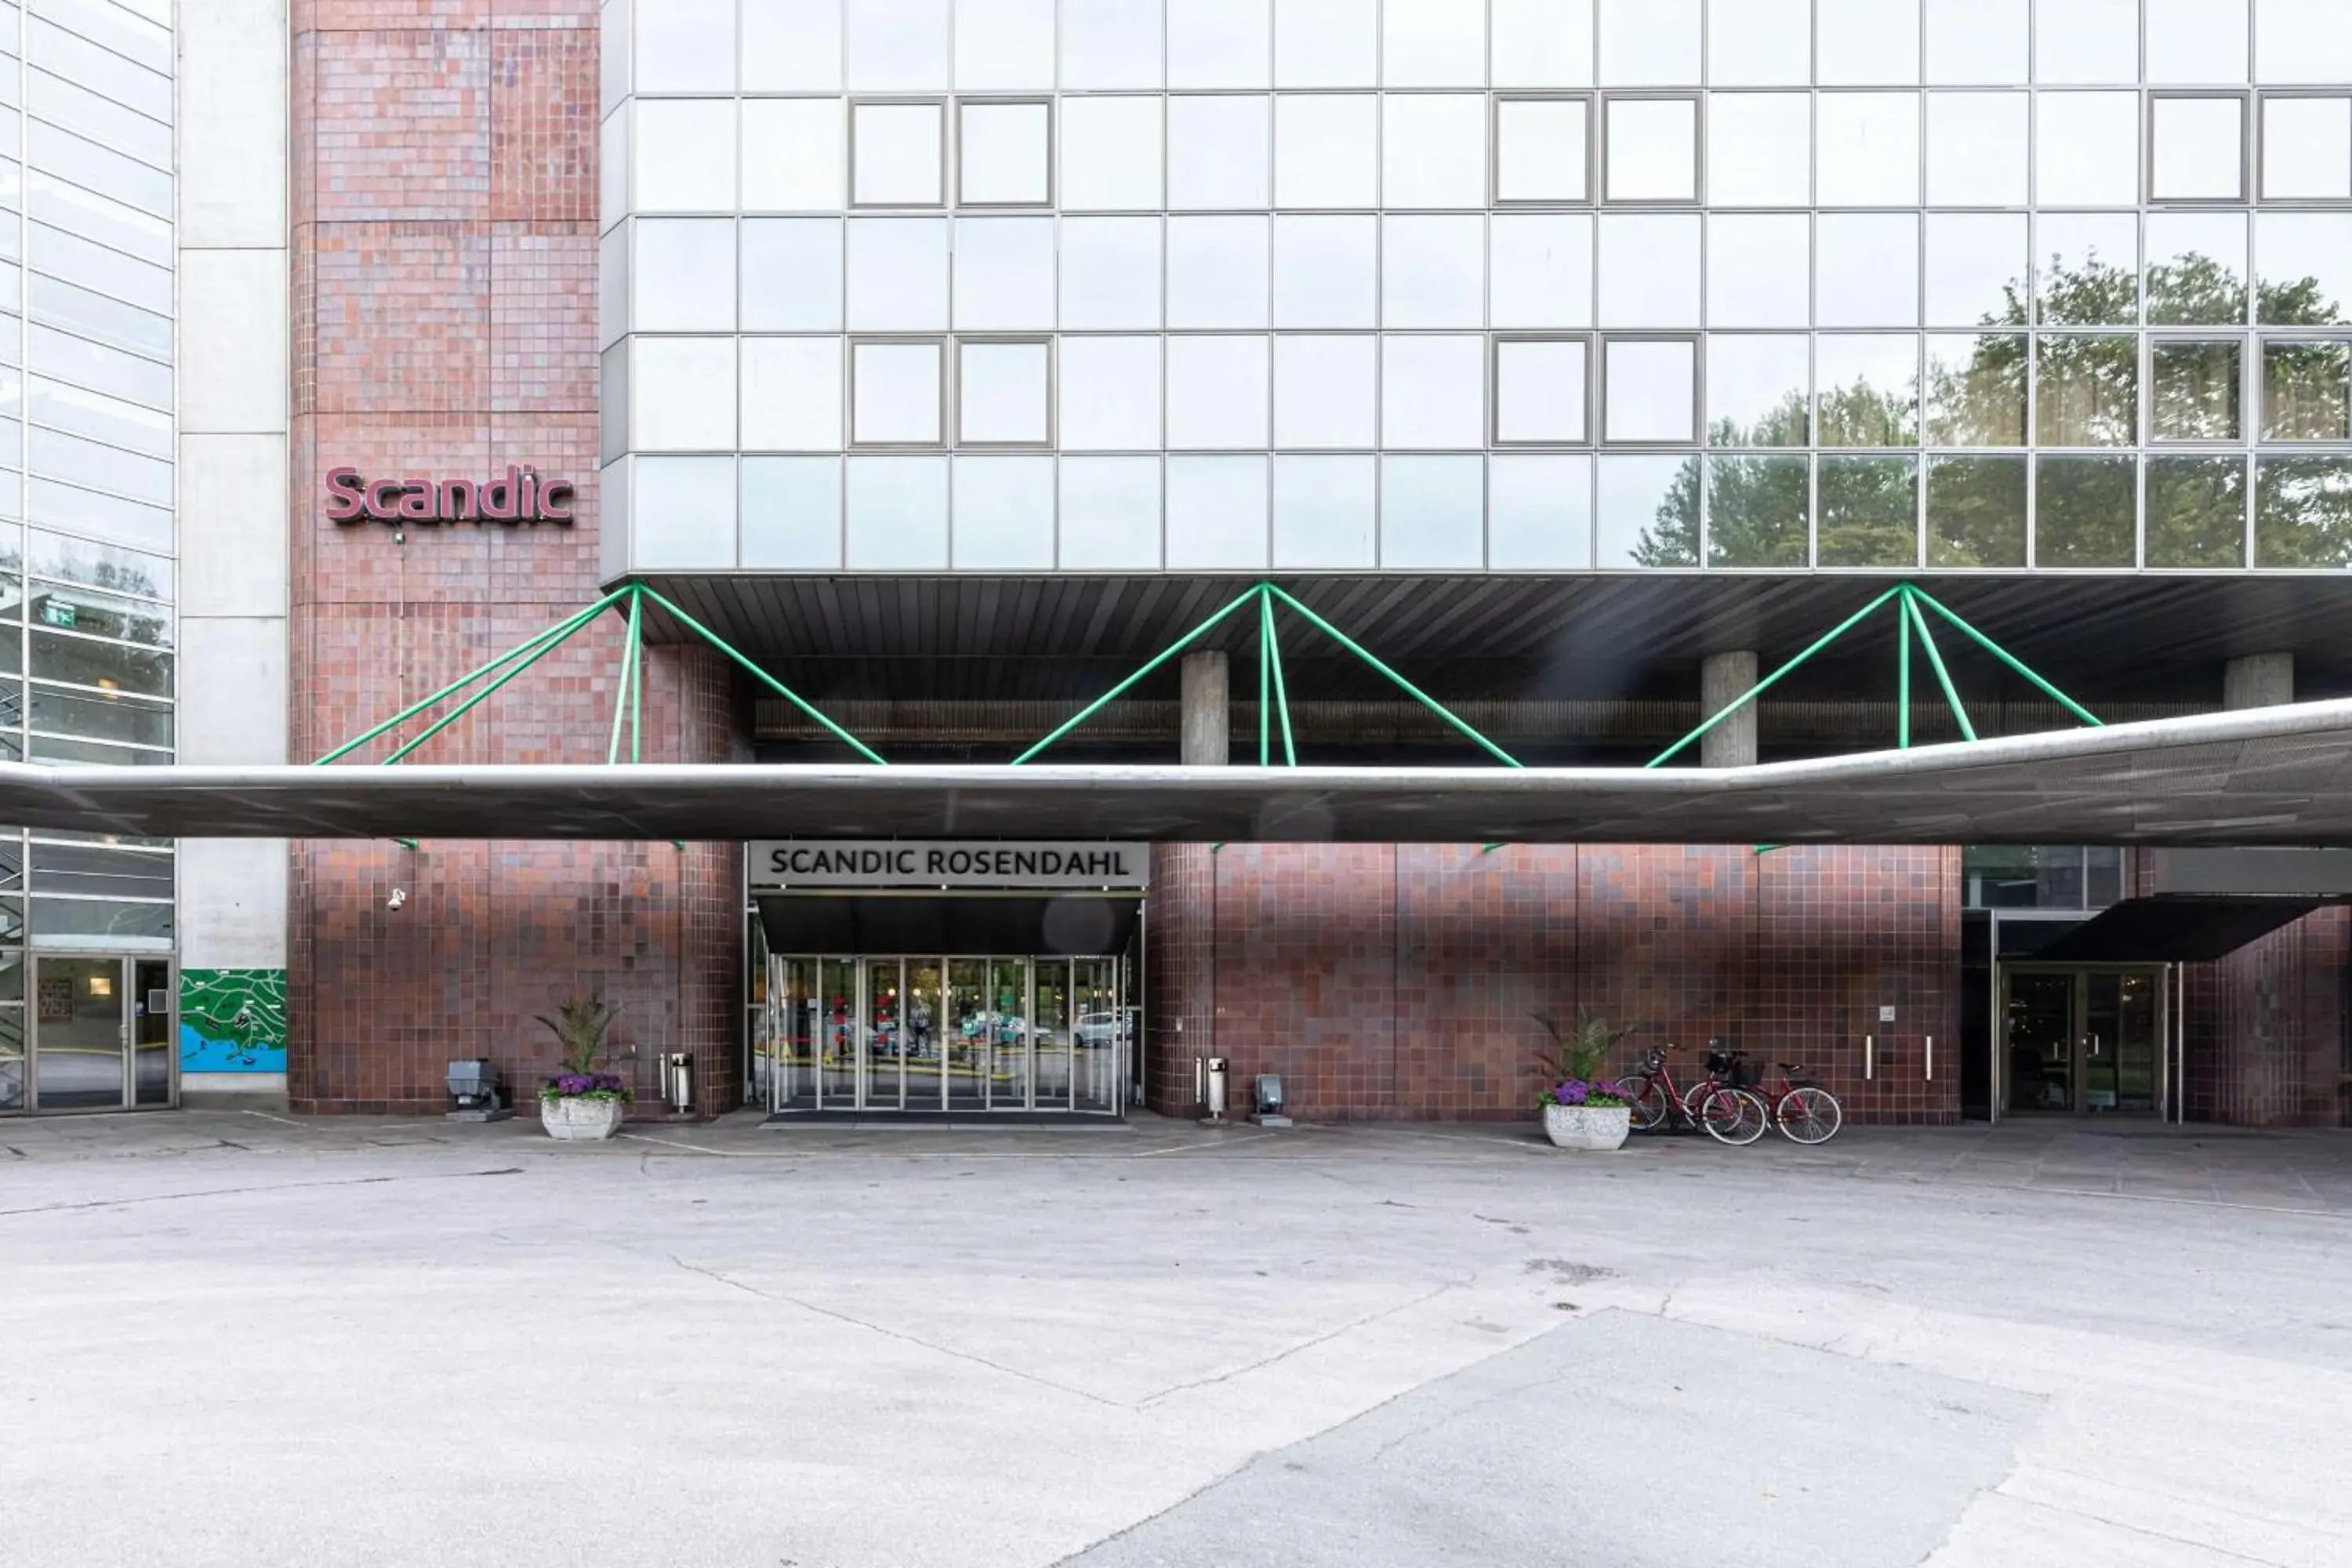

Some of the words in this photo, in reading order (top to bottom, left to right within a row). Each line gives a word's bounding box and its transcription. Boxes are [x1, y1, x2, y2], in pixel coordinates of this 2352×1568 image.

[325, 463, 574, 523] Scandic
[771, 849, 916, 874] SCANDIC
[927, 850, 1130, 876] ROSENDAHL
